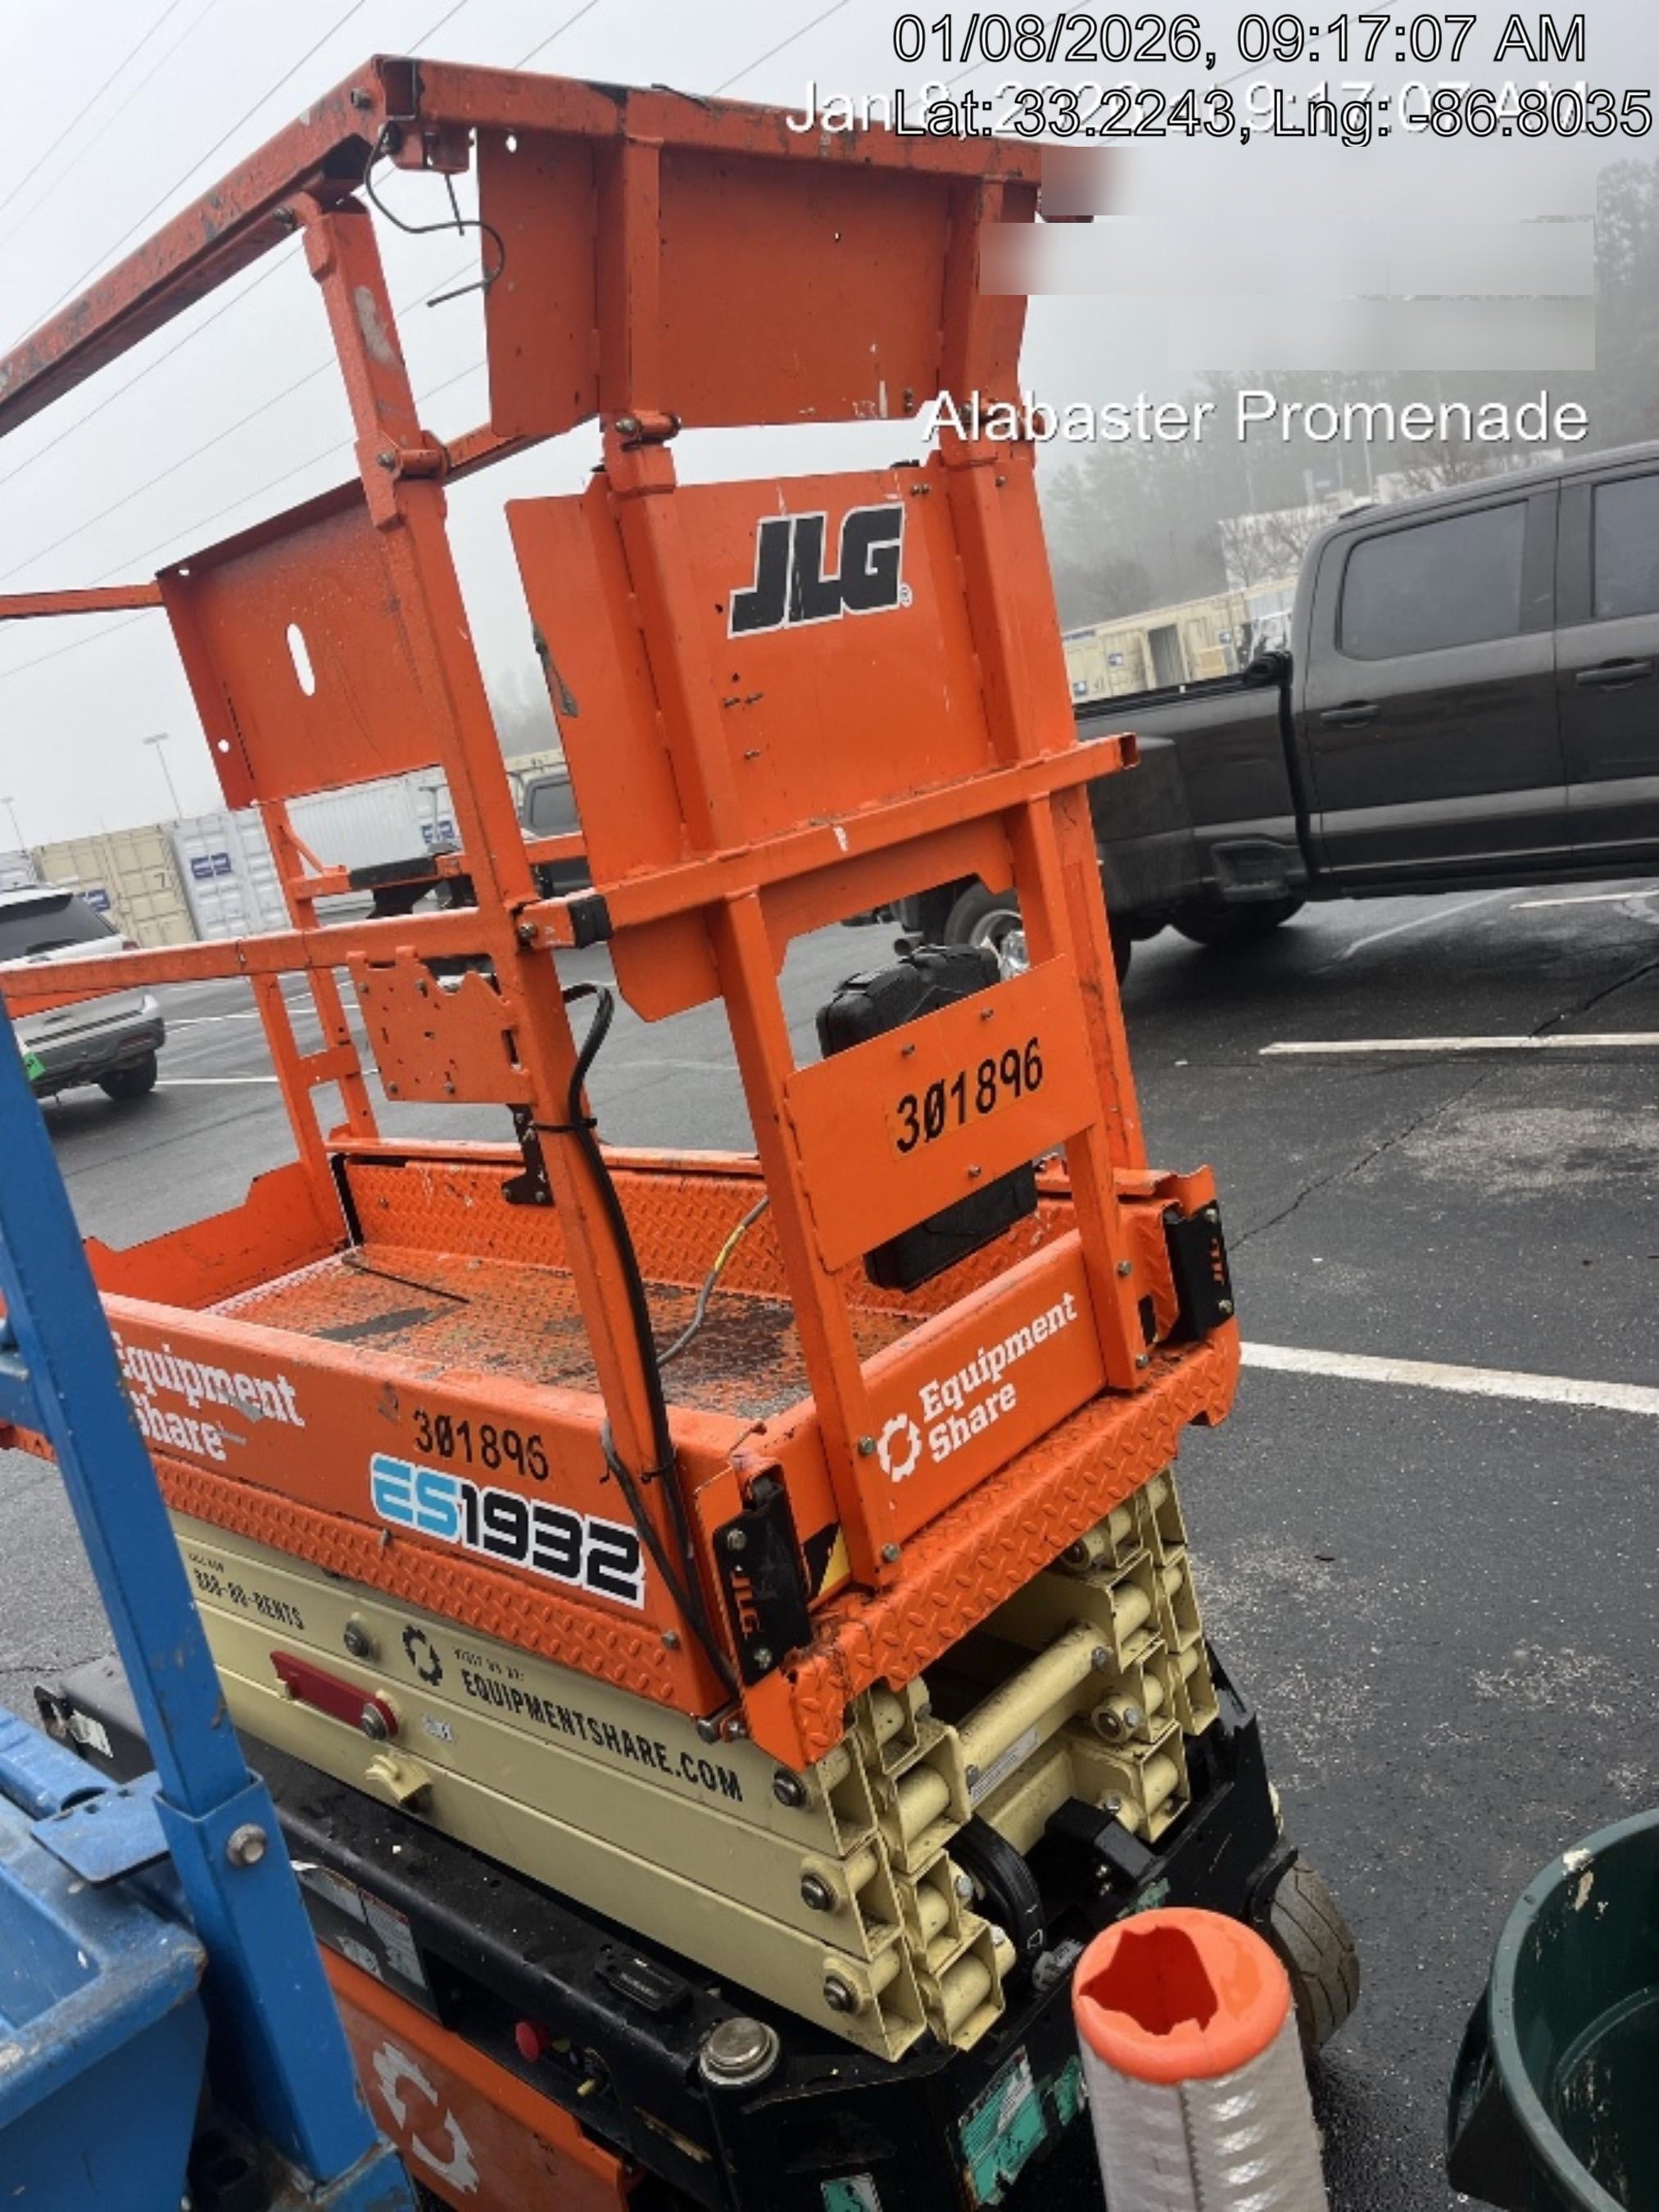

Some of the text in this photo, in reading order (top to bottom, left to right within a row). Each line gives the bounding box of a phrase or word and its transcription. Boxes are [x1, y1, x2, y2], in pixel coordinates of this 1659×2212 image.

[728, 501, 905, 639] JLG
[918, 1292, 1078, 1424] Equipment
[927, 1383, 1017, 1463] Share
[371, 1453, 645, 1620] ES1932
[461, 1668, 743, 1802] EQUIPMENTSHARE.COM
